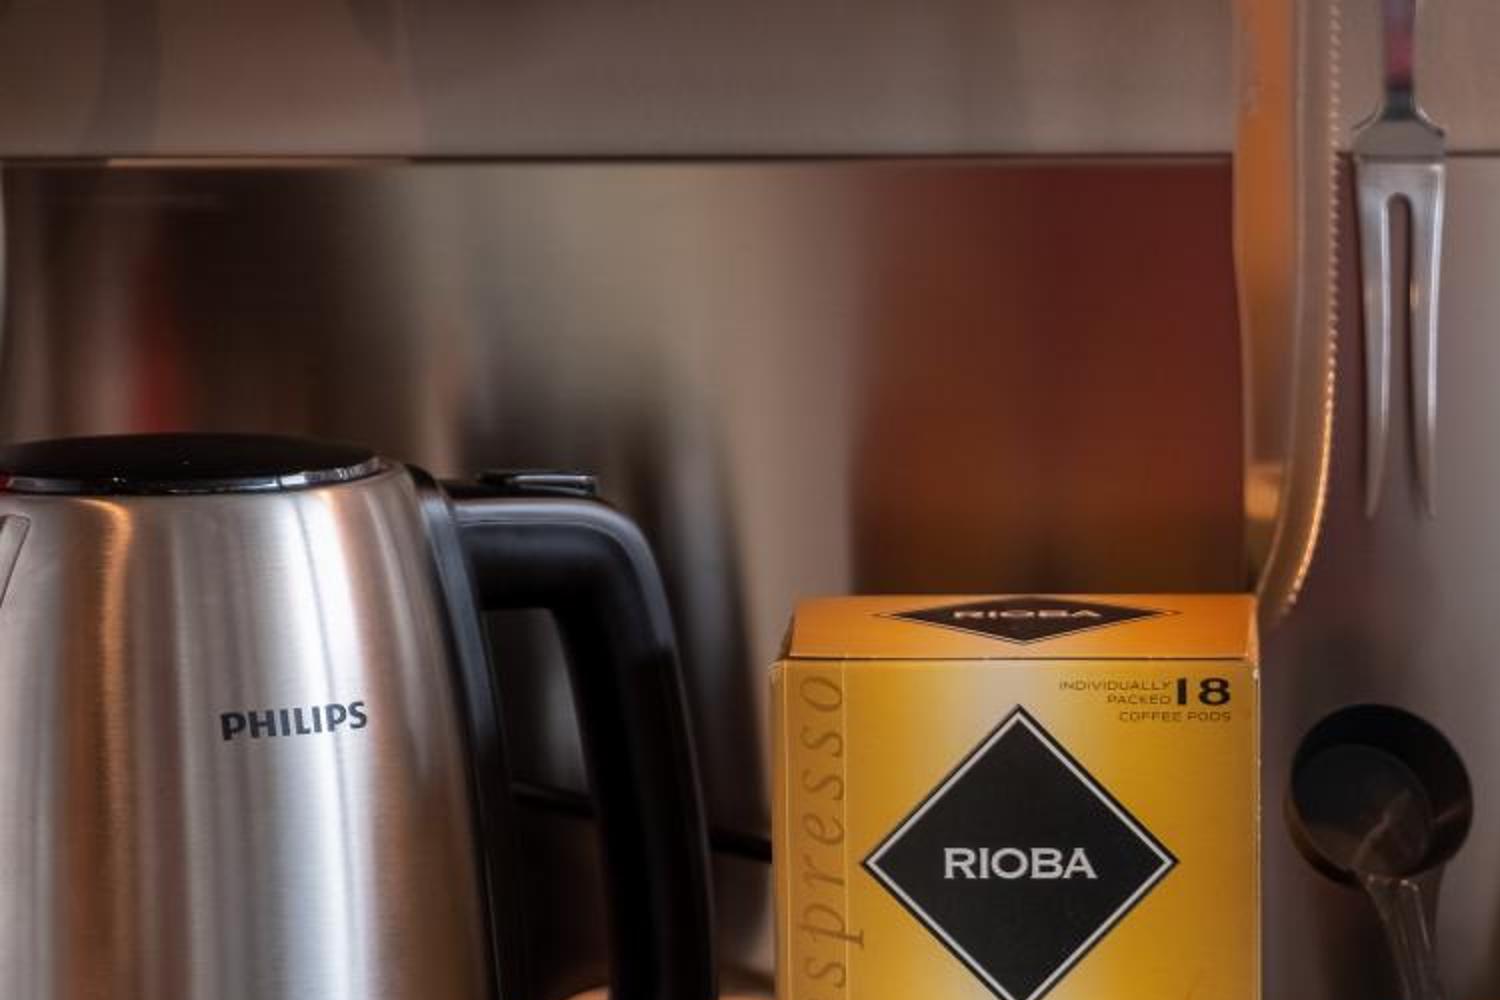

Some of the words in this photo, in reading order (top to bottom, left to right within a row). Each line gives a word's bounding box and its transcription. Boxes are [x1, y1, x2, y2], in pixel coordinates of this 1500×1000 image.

[953, 608, 1102, 619] RIOBA
[1059, 678, 1174, 692] INDIVIDUALLY
[1176, 676, 1231, 706] 18
[1107, 694, 1172, 705] PACKED
[220, 701, 368, 741] PHILIPS
[1118, 710, 1182, 723] COFFEE
[1187, 710, 1232, 722] PODS
[943, 847, 1099, 880] RIOBA
